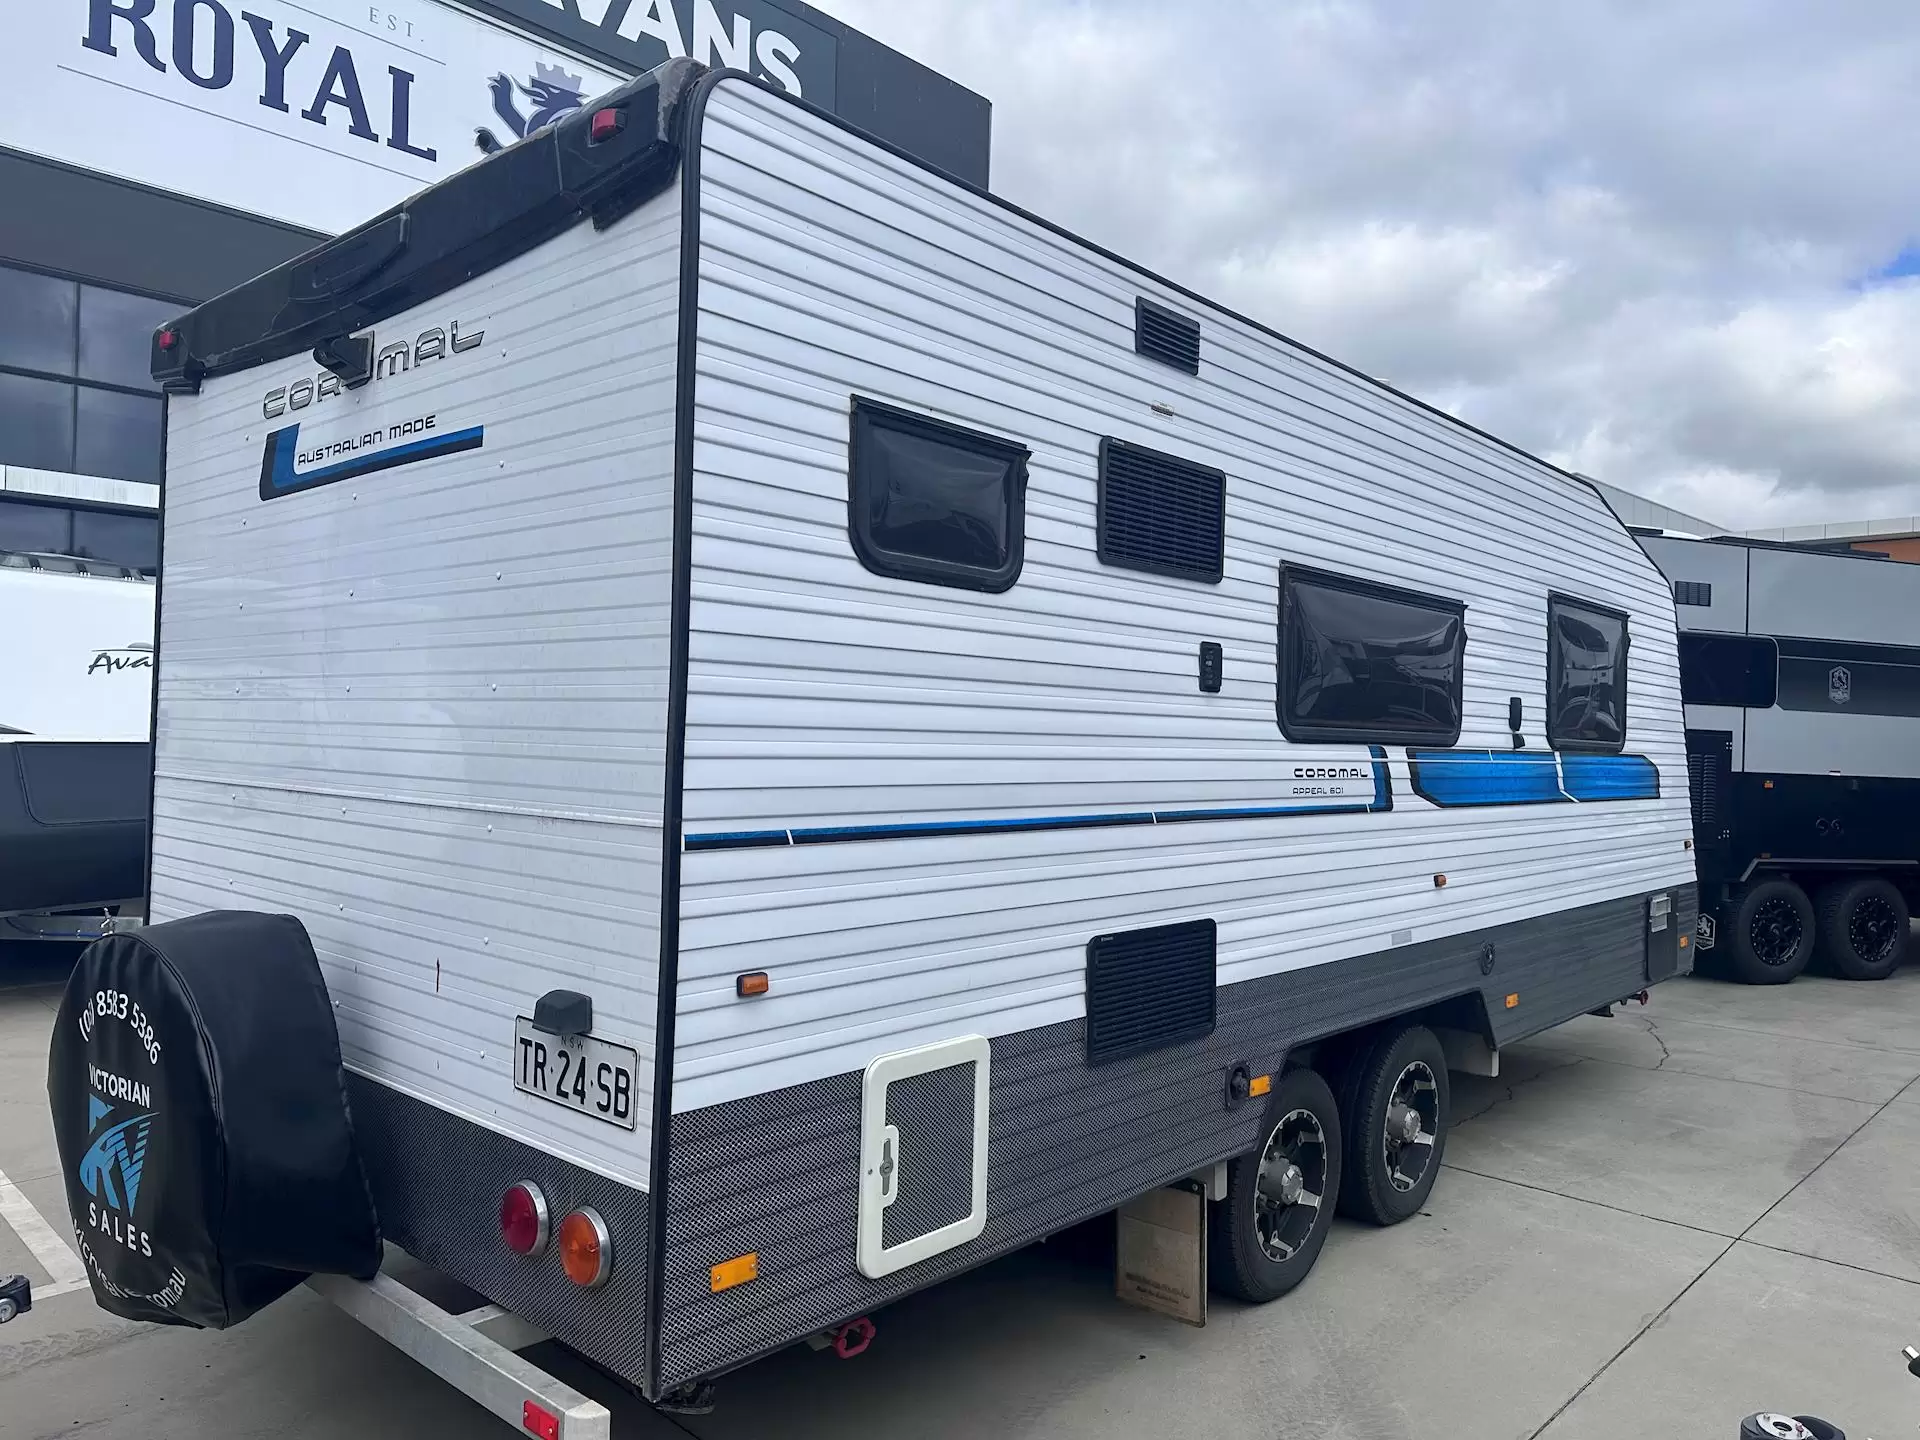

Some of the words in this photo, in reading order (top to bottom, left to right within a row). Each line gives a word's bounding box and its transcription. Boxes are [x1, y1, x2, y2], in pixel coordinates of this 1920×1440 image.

[368, 6, 426, 43] EST.
[82, 0, 437, 162] ROYAL
[263, 319, 486, 420] CORMAL
[297, 430, 383, 466] AUSTRALIAN
[388, 414, 437, 440] MADE
[1292, 787, 1327, 795] APPEAL
[1329, 787, 1344, 795] 601
[1293, 768, 1369, 778] COROMAL
[96, 989, 128, 1020] 8583
[130, 1002, 161, 1065] 5386
[88, 1062, 150, 1109] VICTORIAN
[88, 1201, 152, 1257] SALES
